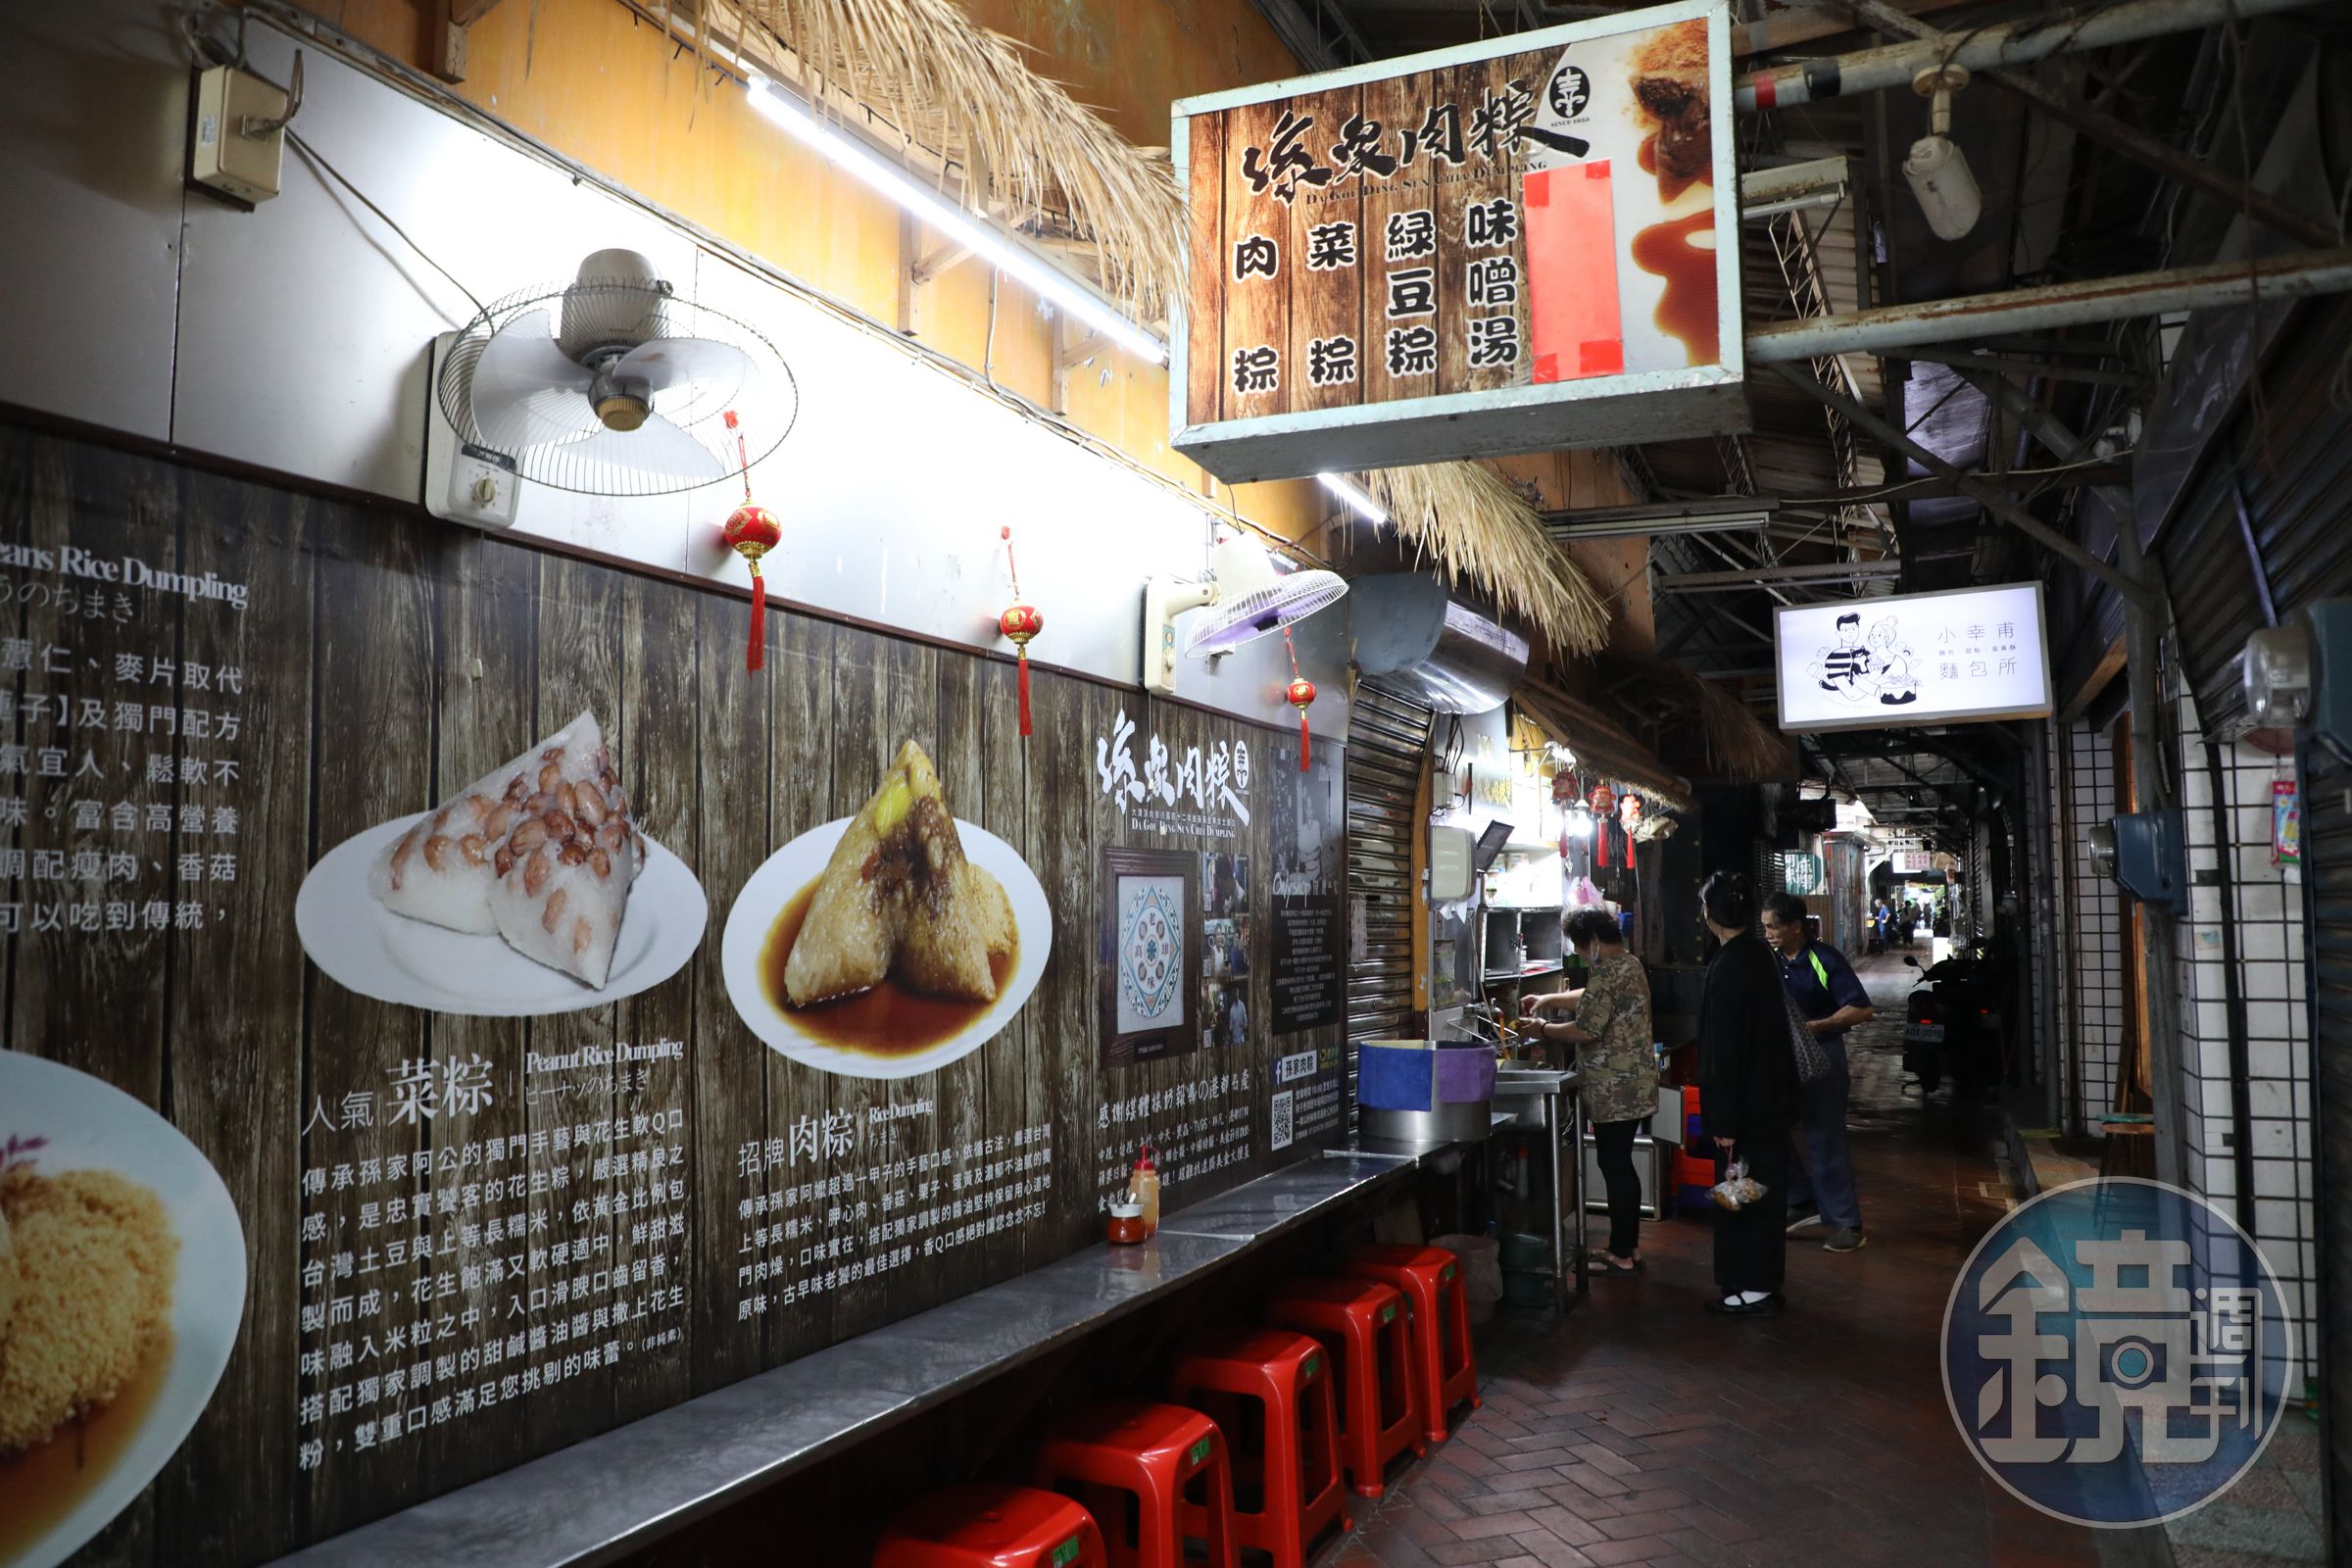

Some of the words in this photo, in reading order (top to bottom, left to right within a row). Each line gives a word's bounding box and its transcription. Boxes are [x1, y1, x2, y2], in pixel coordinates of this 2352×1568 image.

[1468, 198, 1518, 366] 味噌湯
[59, 545, 119, 581] Rice
[122, 556, 248, 611] Dumpling
[526, 1052, 580, 1074] Peanut
[583, 1045, 614, 1067] Rice
[616, 1037, 683, 1063] Dumpling
[1286, 1054, 1313, 1078] 孫家肉粽
[302, 1091, 374, 1137] 人氣
[385, 1053, 494, 1126] 菜粽
[869, 1106, 890, 1125] Rice
[891, 1099, 933, 1119] Dumpling
[738, 1137, 784, 1177] 招牌
[790, 1107, 854, 1167] 肉粽
